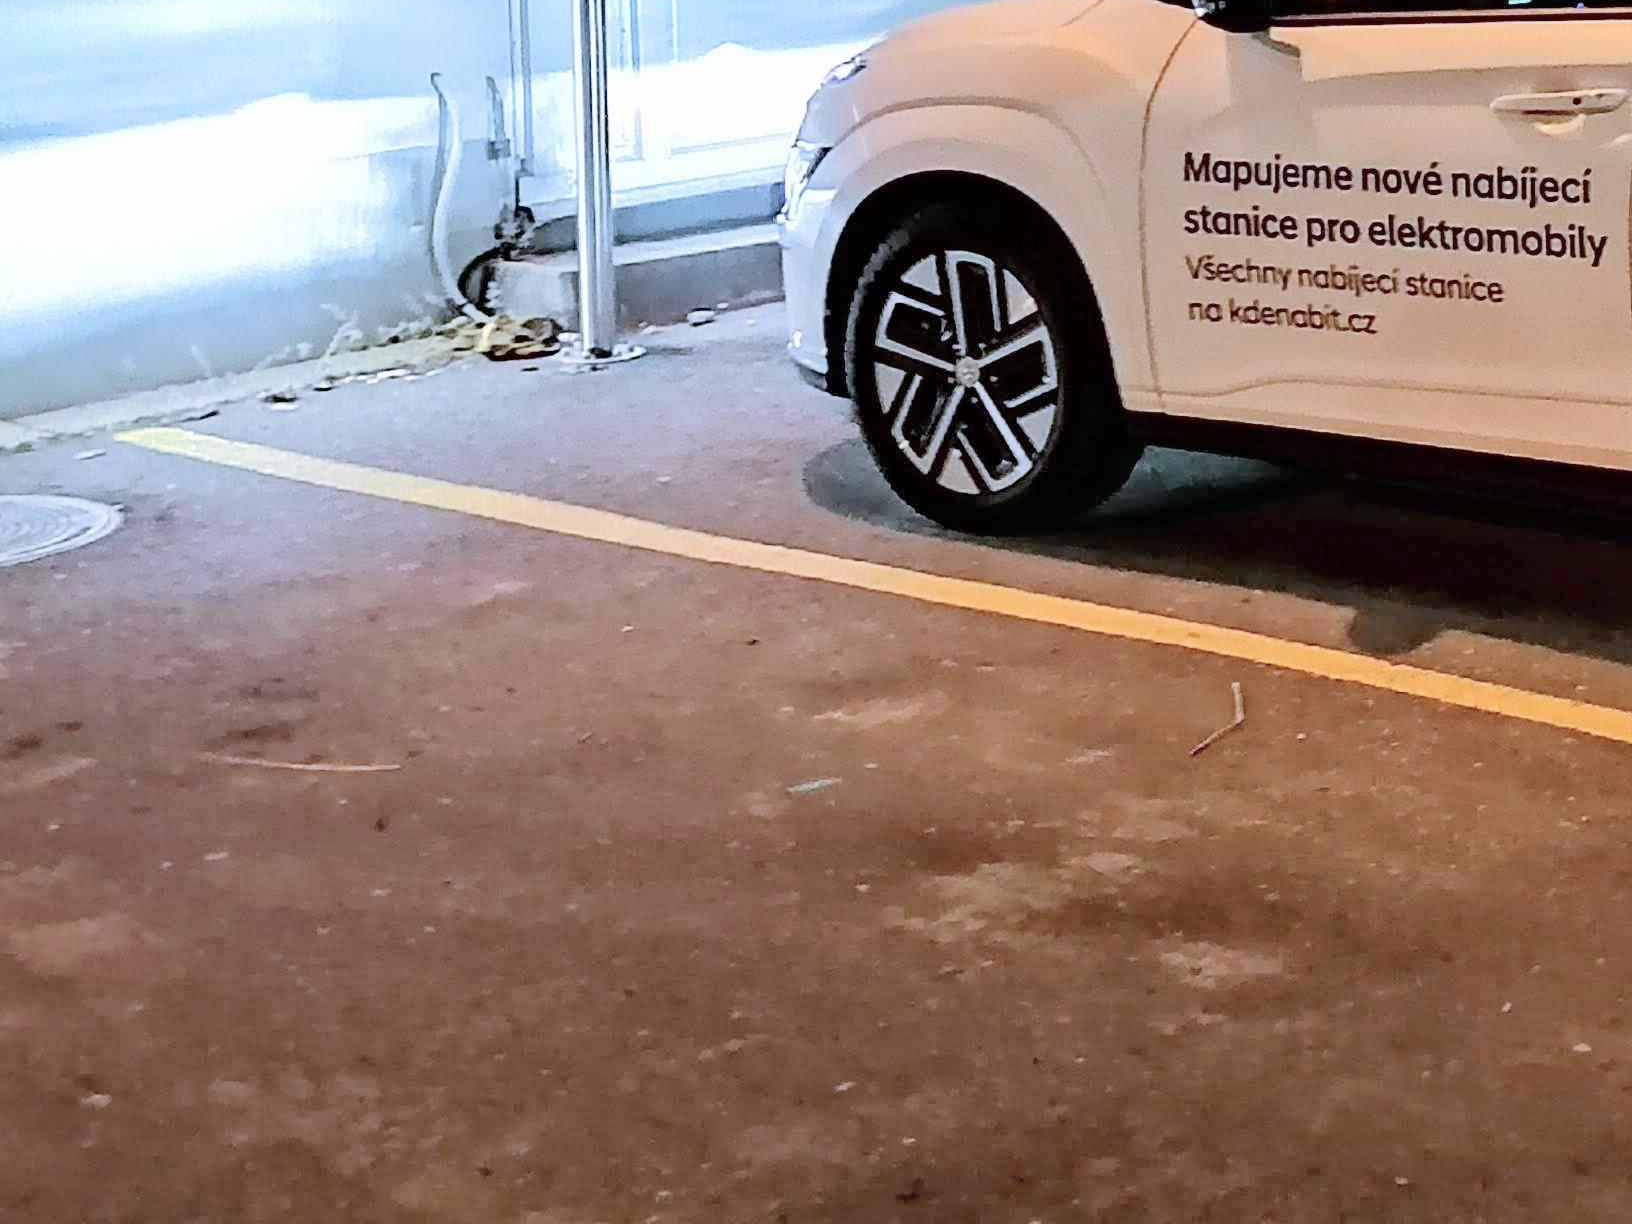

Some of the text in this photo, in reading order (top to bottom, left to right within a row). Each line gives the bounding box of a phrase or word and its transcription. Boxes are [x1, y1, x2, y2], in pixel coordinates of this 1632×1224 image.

[1184, 151, 1593, 208] Mapujeme nové nabíjecí
[1184, 205, 1608, 267] stanice pro elektromobily
[1185, 256, 1292, 291] Všechny
[1405, 273, 1505, 303] stanice
